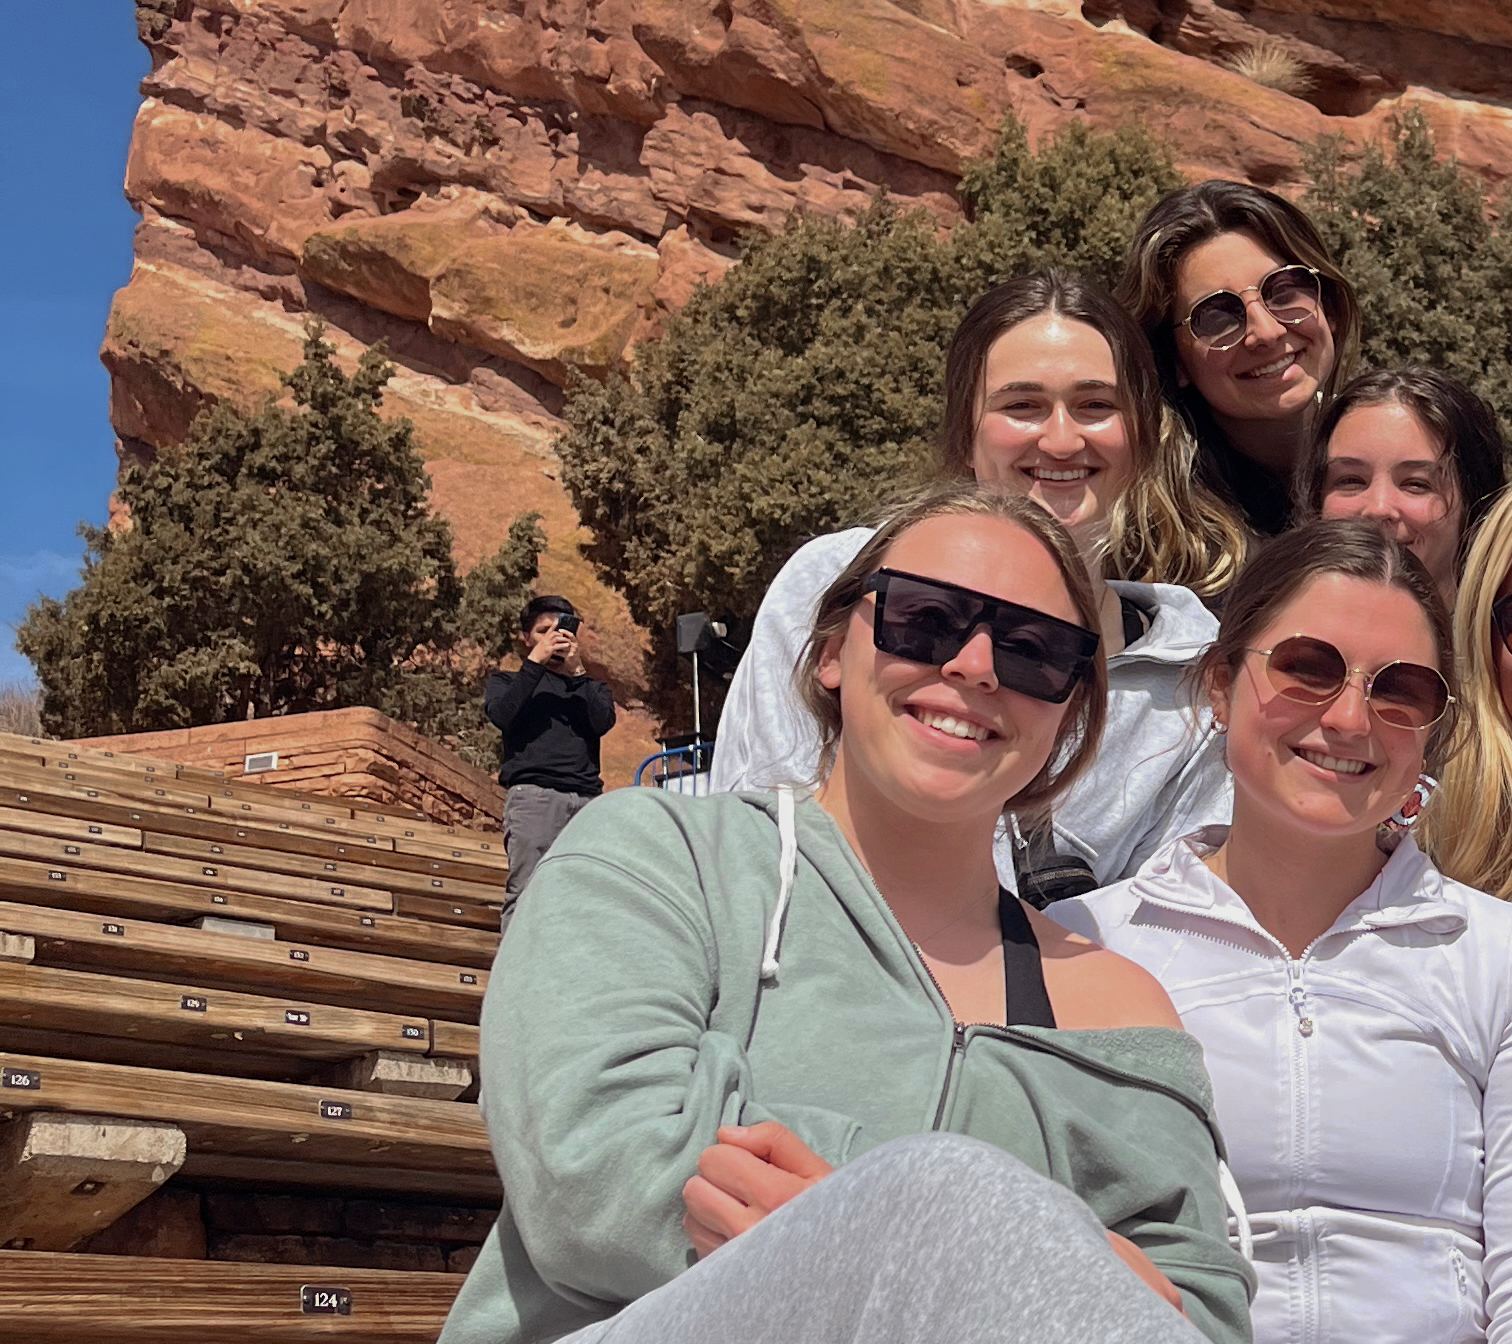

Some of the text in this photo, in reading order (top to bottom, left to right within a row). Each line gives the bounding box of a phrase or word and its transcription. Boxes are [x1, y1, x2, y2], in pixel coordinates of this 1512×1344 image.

[11, 1074, 30, 1086] 126
[327, 1106, 343, 1116] 127
[314, 1292, 338, 1308] 124
